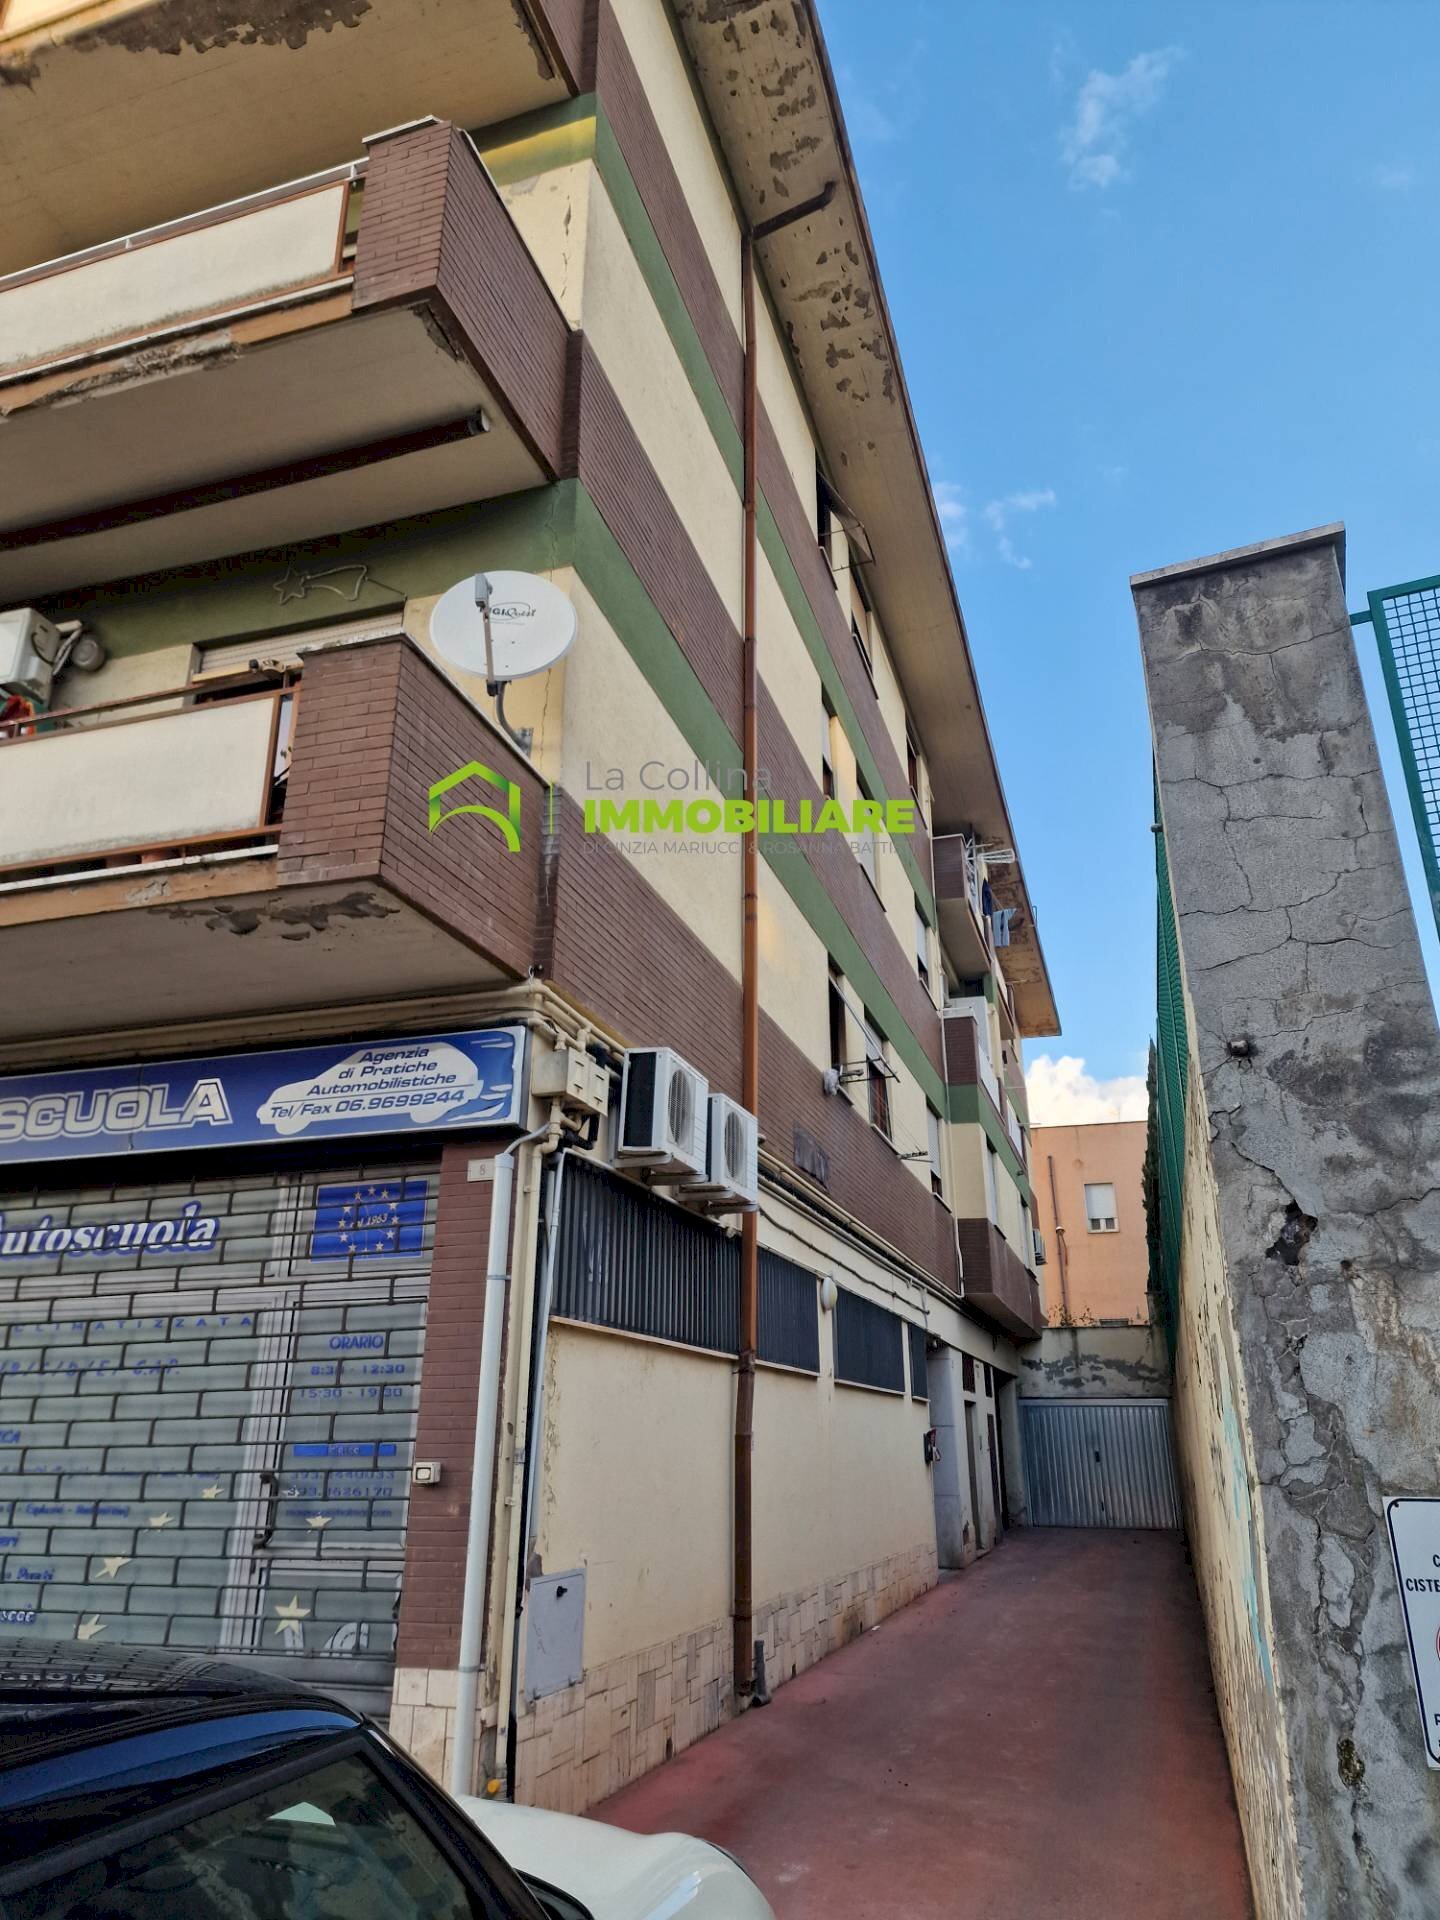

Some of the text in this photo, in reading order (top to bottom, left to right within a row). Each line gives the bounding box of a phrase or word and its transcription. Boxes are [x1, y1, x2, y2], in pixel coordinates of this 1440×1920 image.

[358, 1047, 429, 1064] Agenzia
[338, 1061, 438, 1079] di Pratiche
[307, 1073, 457, 1096] Automobilistiche
[0, 1080, 232, 1142] SCUOLA
[270, 1089, 465, 1119] Tel/Fax 06.9699244
[480, 1164, 486, 1176] 8
[0, 1202, 218, 1258] utoscuola
[329, 1335, 384, 1350] ORARIO
[363, 1363, 405, 1375] 12:30
[300, 1387, 342, 1399] 15:30
[360, 1387, 404, 1398] 1930
